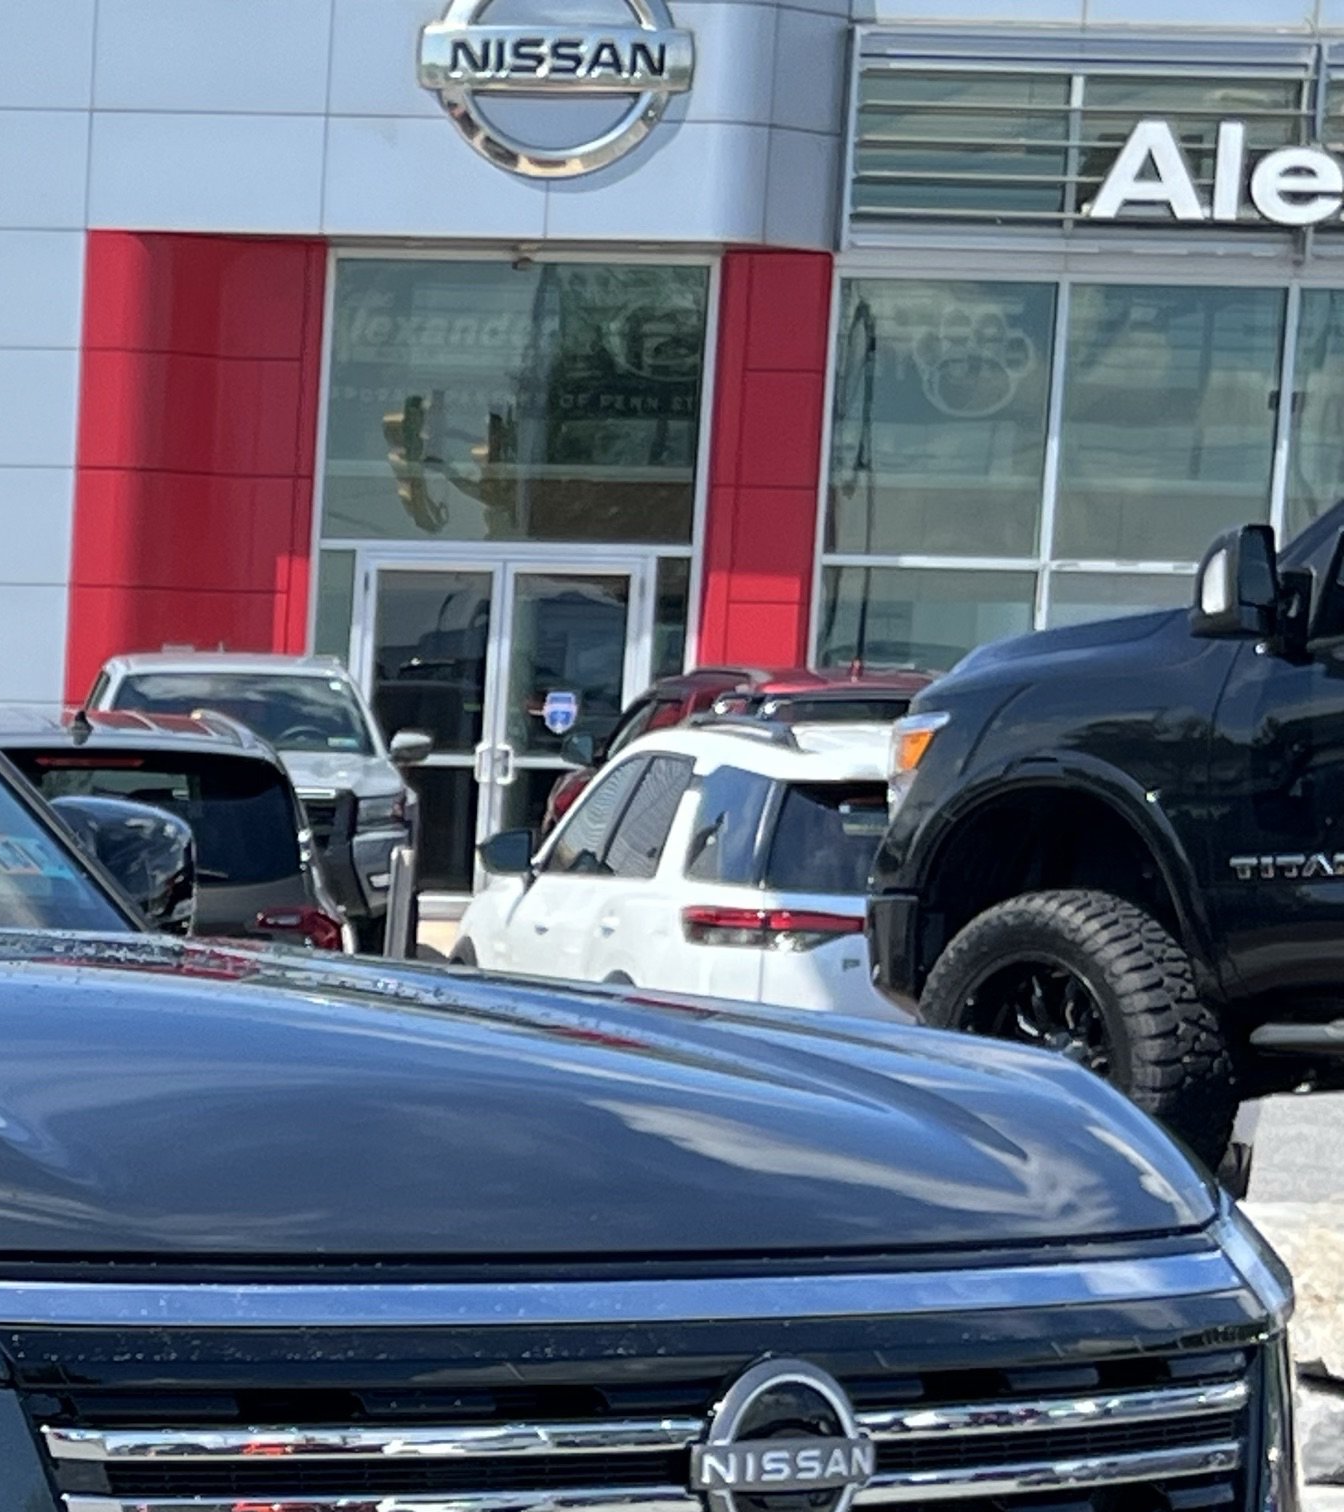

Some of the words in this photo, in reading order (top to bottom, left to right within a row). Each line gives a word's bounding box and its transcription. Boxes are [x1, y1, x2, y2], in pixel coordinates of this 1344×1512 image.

[449, 37, 667, 77] NISSAN
[1089, 120, 1343, 225] Ale
[700, 1446, 874, 1485] NISSAN
